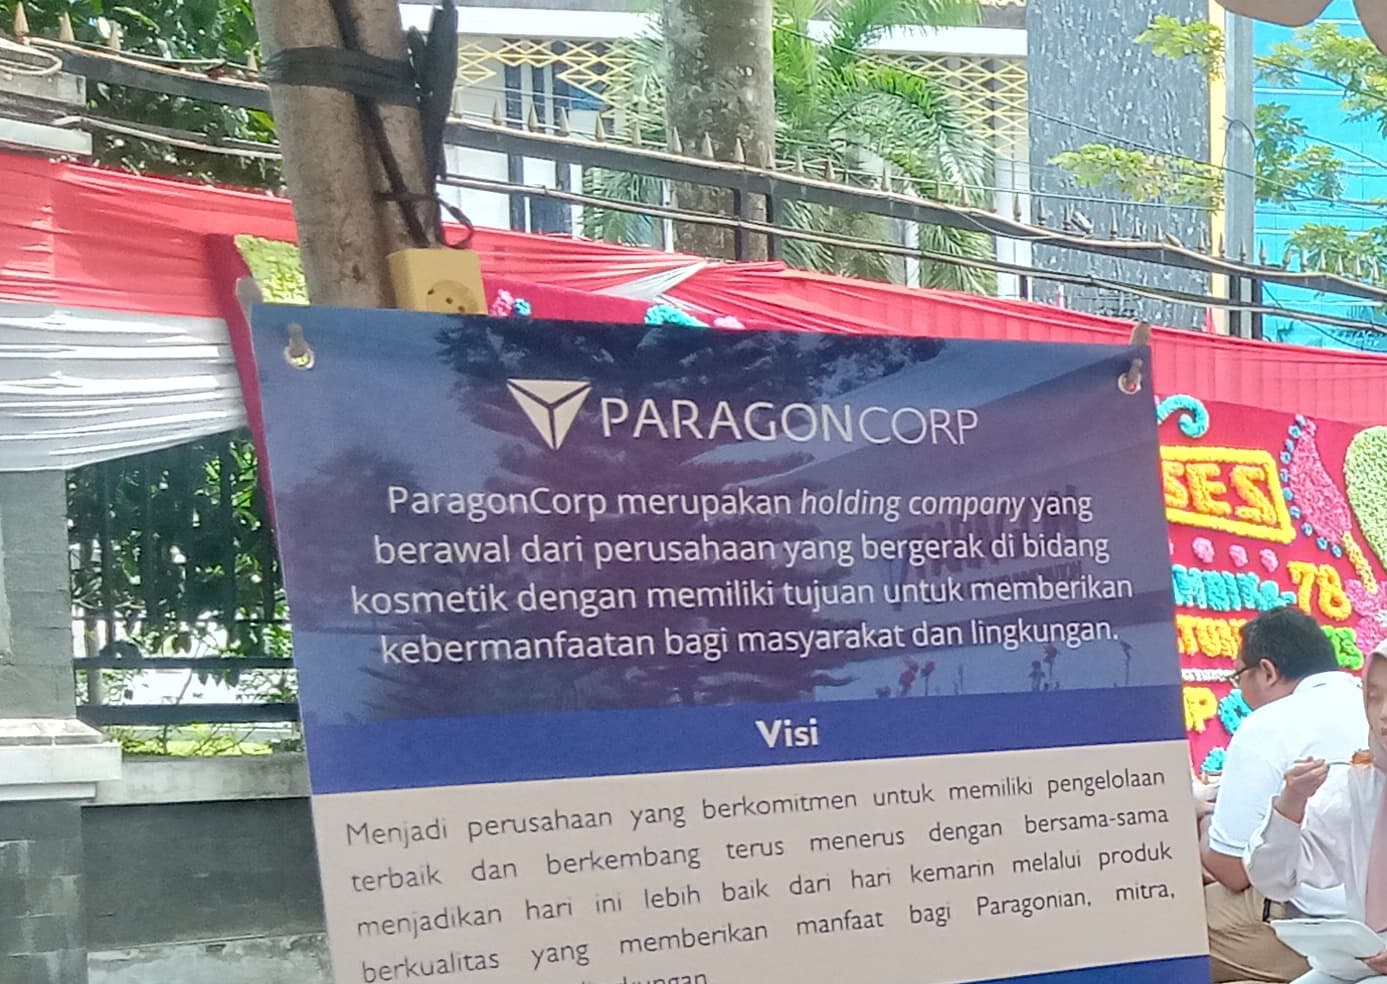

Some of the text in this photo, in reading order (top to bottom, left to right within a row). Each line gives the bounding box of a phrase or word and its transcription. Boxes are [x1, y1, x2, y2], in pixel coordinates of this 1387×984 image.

[600, 397, 979, 446] PARAGONCORP
[389, 487, 1094, 526] ParagonCorp merupakan holding company yang
[375, 533, 1110, 569] berawal dari perusahaan yang bergerak di bidang
[352, 574, 1133, 618] kosmetik dengan memiliki tujuan untuk memberikan
[381, 618, 1120, 664] kebermanfaatan bagi masyarakat dan lingkungan.
[755, 718, 818, 748] Visi
[347, 768, 1164, 848] Menjadi perusahaan yang berkomitmen untuk memiliki pengelolaan
[352, 809, 1169, 892] terbaik dan berkembang terus menerus dengan bersama-sama
[358, 841, 1172, 939] menjadikan hari ini lebih baik dari hari kemarin melalui produk
[362, 952, 499, 983] berkualitas
[531, 944, 590, 971] yang
[620, 922, 768, 954] memberikan
[797, 909, 884, 935] manfaat
[909, 904, 950, 927] bagi
[1116, 882, 1175, 901] mitra,
